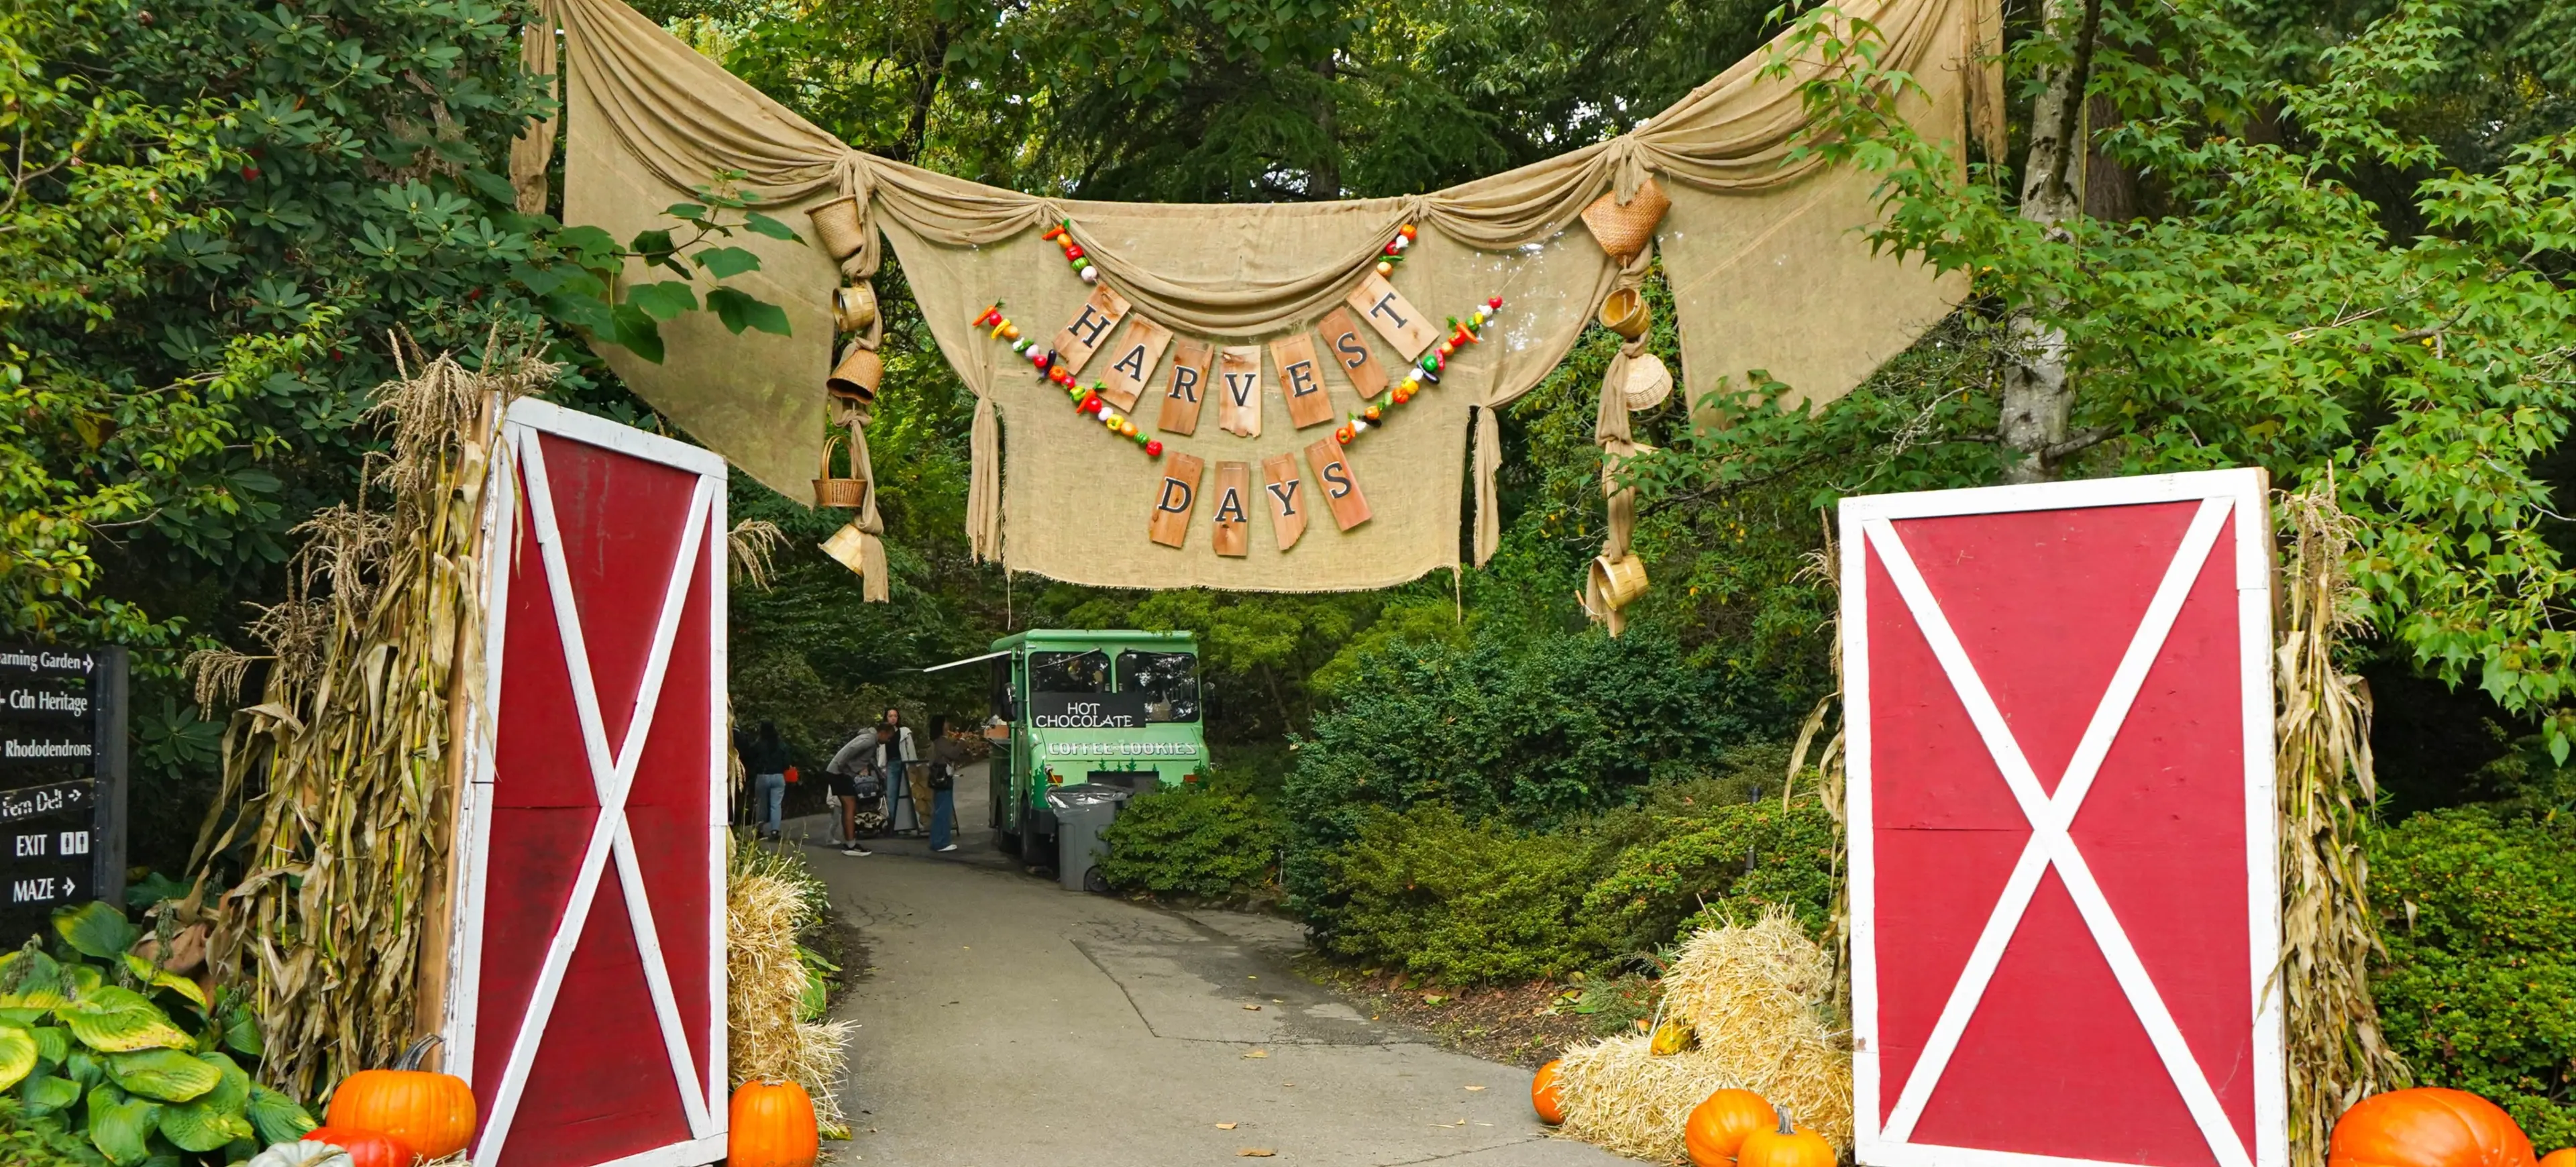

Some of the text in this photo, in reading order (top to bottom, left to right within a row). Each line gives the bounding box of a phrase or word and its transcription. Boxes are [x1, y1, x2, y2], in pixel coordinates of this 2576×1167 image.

[1067, 291, 1409, 408] HARVEST
[1157, 461, 1353, 523] DAYS
[0, 649, 80, 671] arning Garden
[9, 689, 88, 716] Cdn Heritage
[1067, 702, 1101, 715] HOT
[1036, 714, 1134, 728] CHOCOLATE
[5, 739, 92, 757] Rhododendrons
[36, 789, 62, 812] Dell
[16, 834, 48, 856] EXIT
[13, 877, 55, 903] MAZE
